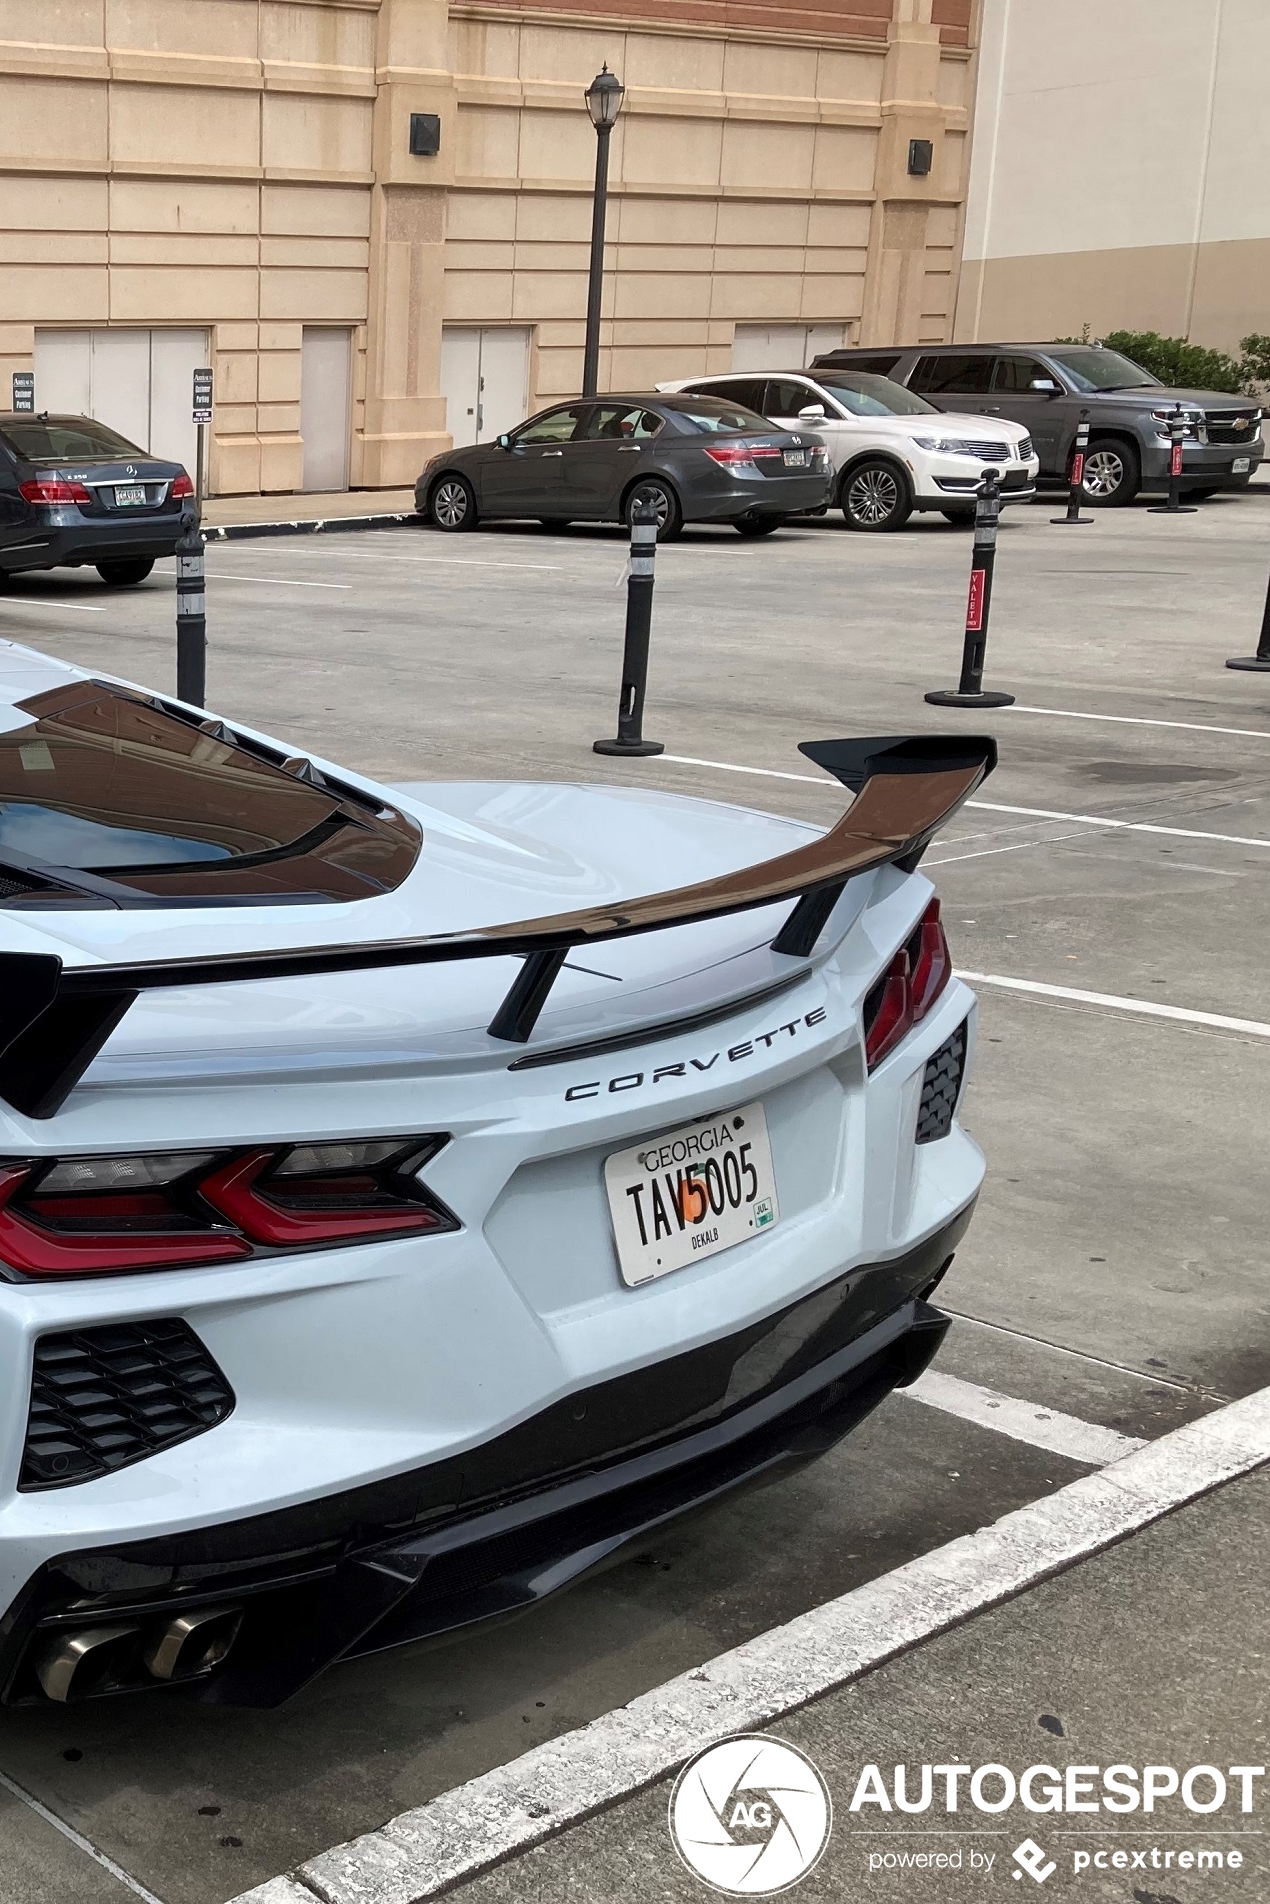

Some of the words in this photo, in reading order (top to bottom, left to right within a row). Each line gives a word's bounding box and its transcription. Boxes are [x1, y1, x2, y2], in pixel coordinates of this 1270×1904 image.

[969, 575, 978, 619] VALET
[564, 1006, 827, 1101] CORVETTE
[644, 1124, 734, 1172] GEORGIA
[626, 1142, 758, 1246] TAV5005
[756, 1203, 769, 1215] JUL
[691, 1227, 719, 1250] DEKALB
